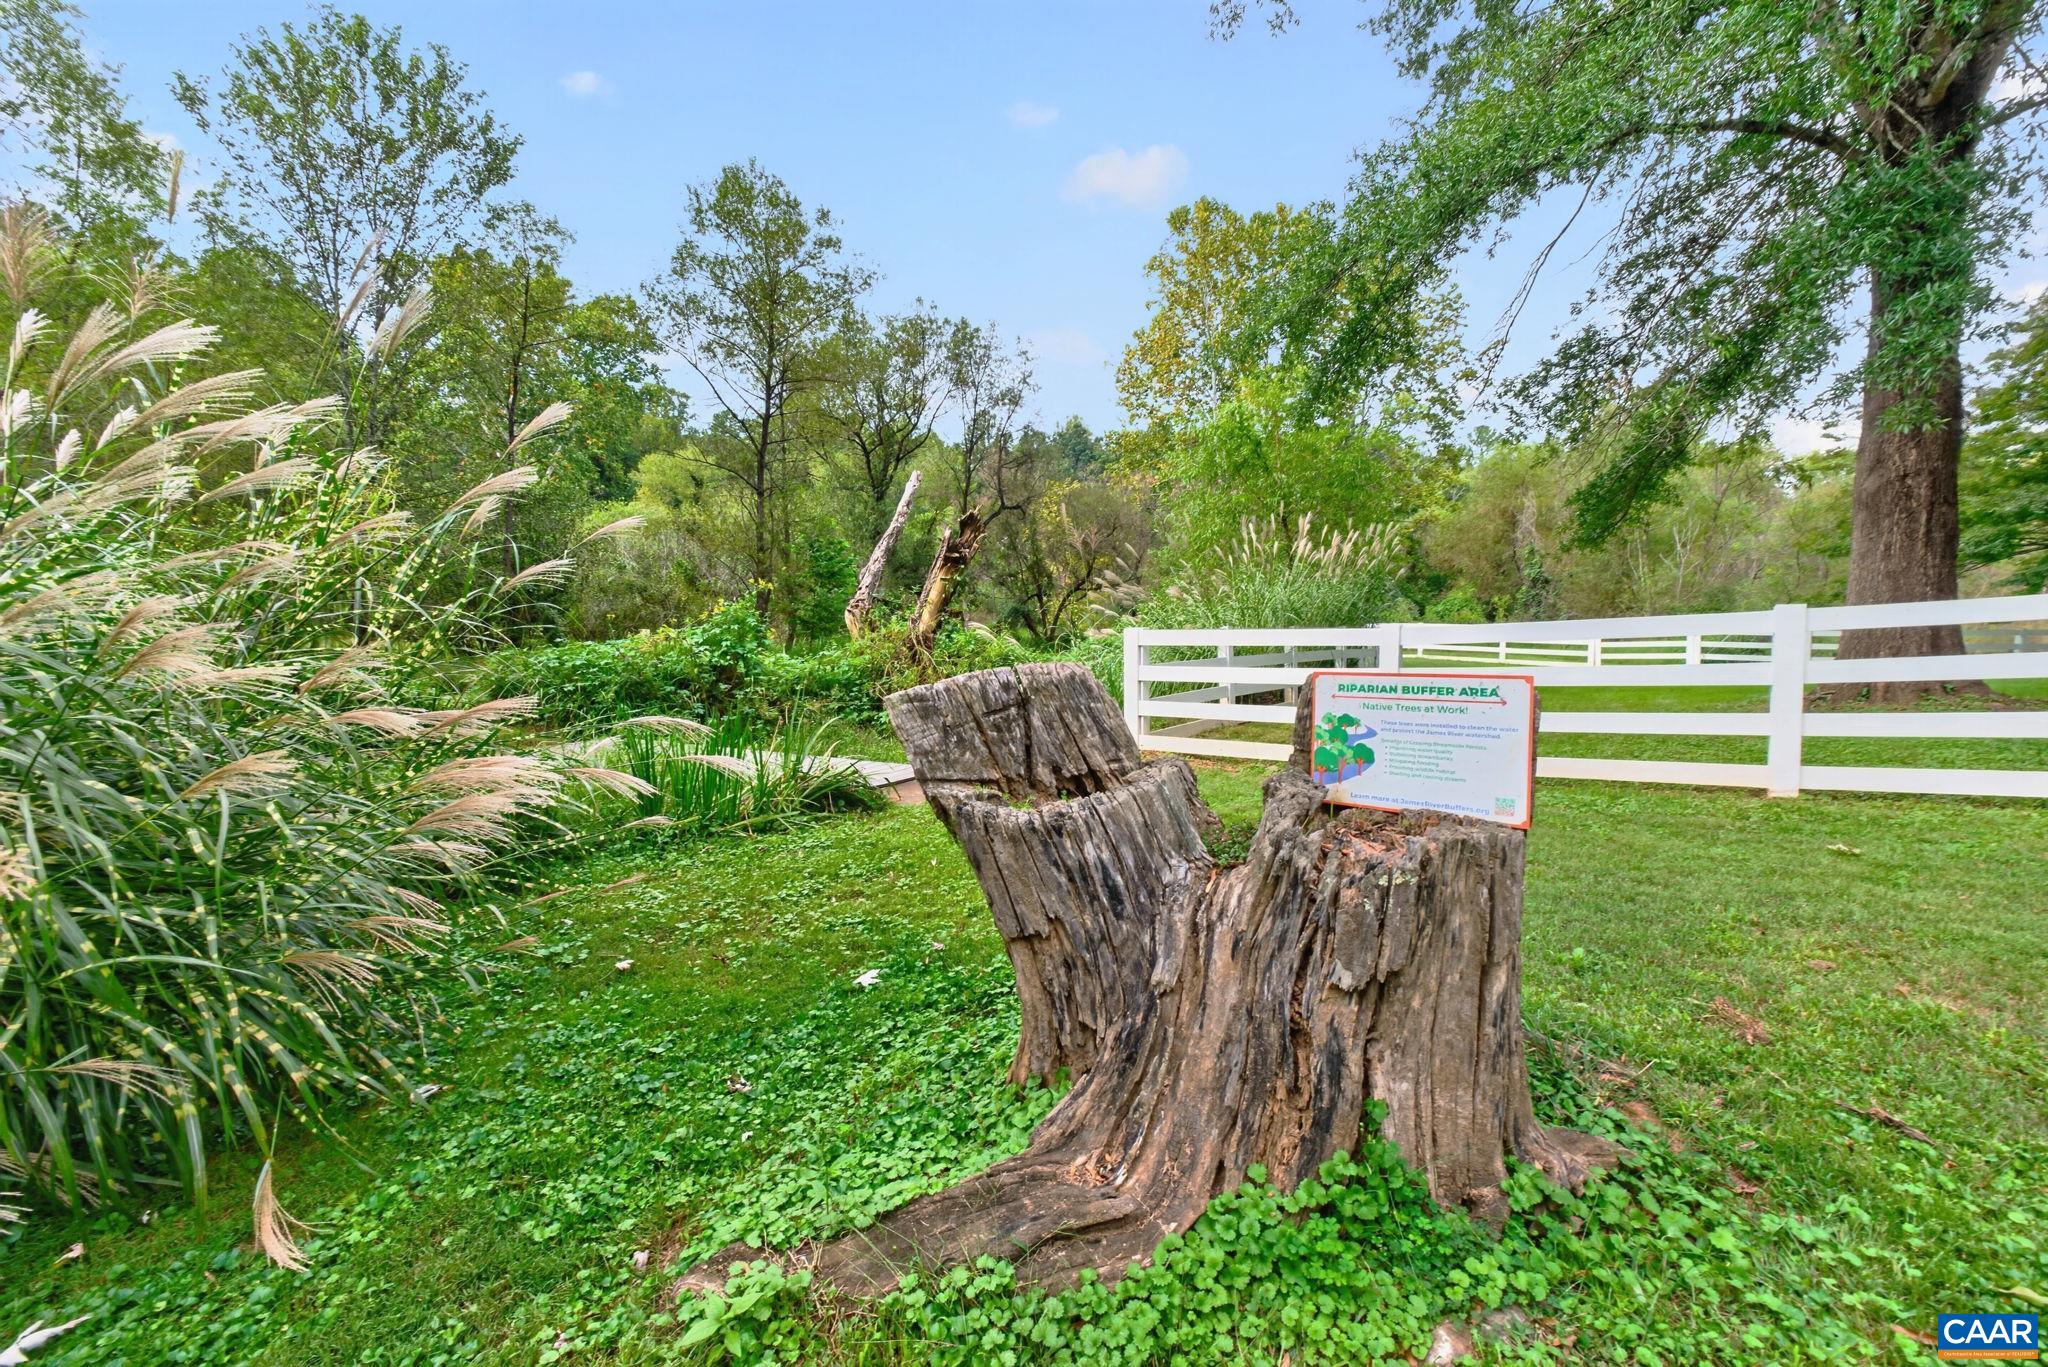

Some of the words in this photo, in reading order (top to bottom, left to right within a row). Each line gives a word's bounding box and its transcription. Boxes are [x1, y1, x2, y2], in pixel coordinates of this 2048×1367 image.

[1338, 684, 1398, 693] RIPARIAN
[1402, 685, 1454, 696] BUFFER
[1459, 687, 1500, 697] AREA
[1362, 703, 1392, 711] Native
[1395, 704, 1421, 712] Trees
[1424, 705, 1434, 713] at
[1437, 705, 1468, 714] Work!
[1350, 792, 1370, 800] Learn
[1400, 798, 1490, 815] JamesRiverBuffers.org
